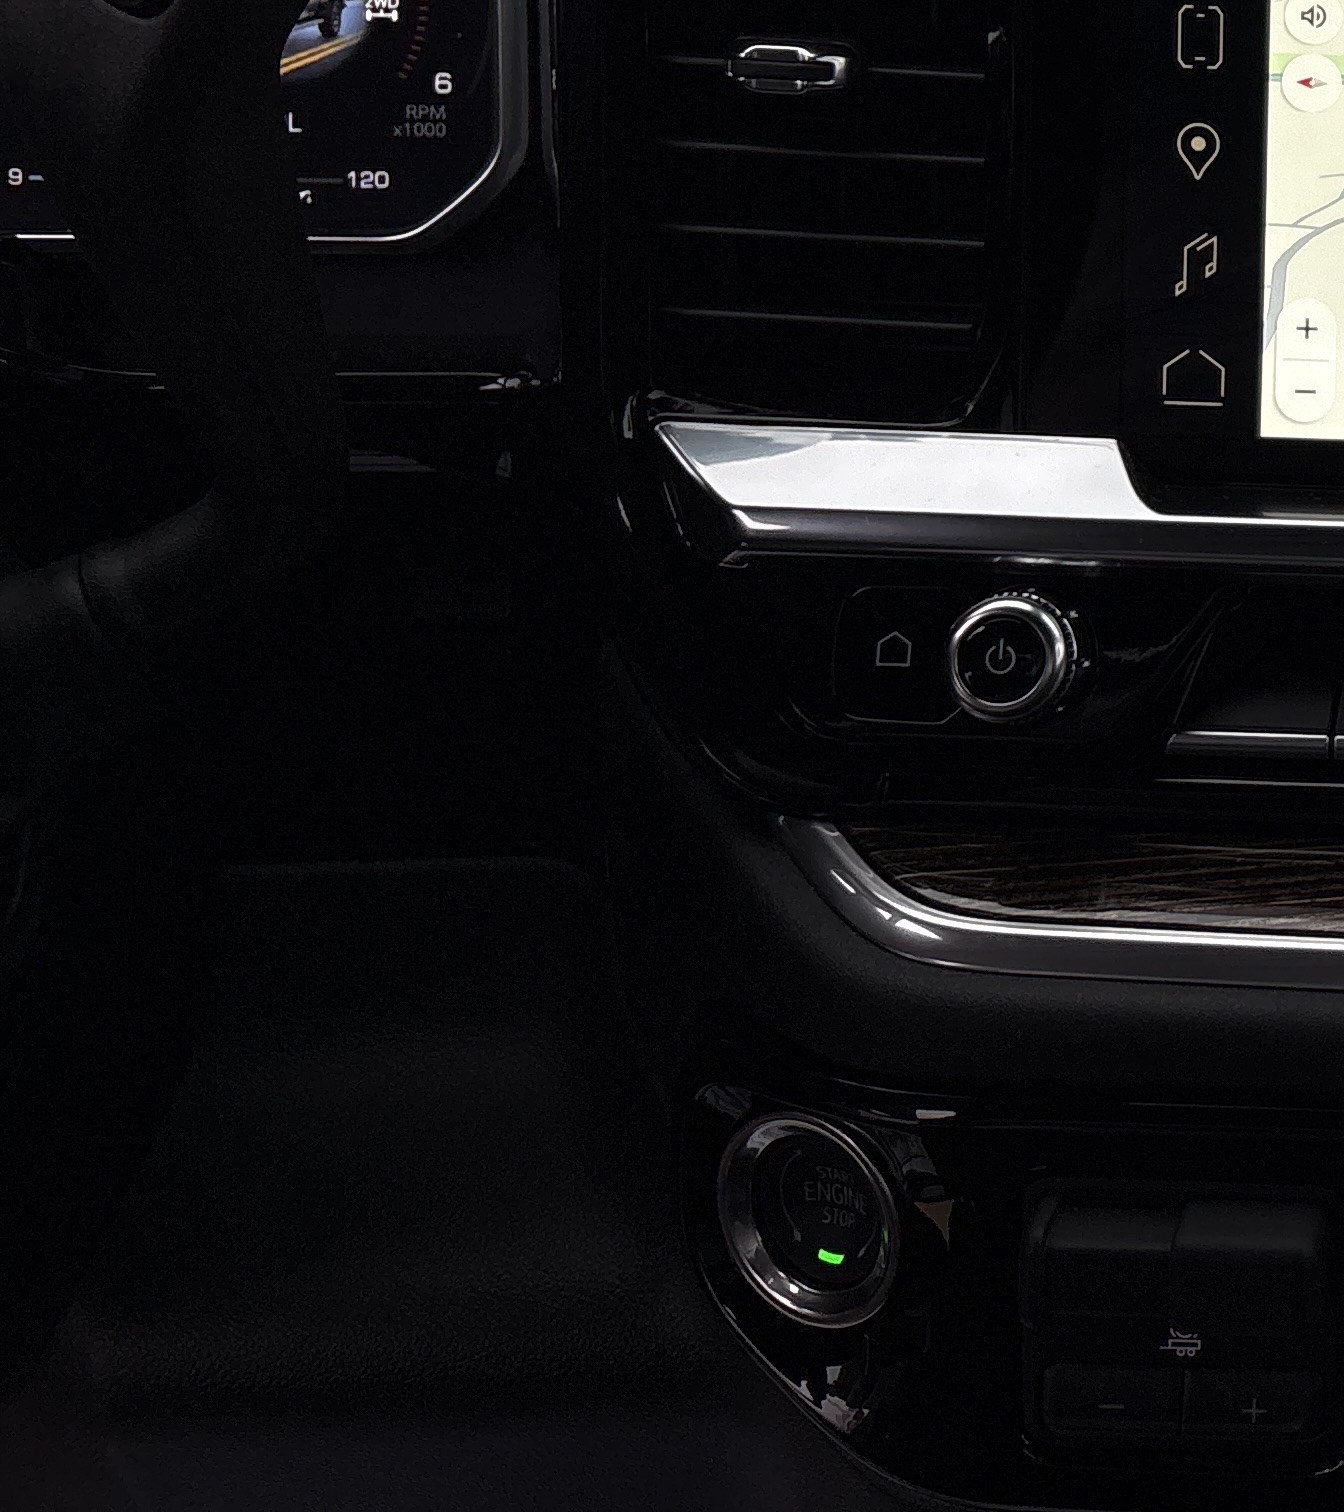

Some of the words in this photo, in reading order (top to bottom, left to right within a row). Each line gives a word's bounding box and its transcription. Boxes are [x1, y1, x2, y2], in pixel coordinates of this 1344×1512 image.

[434, 72, 453, 95] 6
[405, 104, 447, 120] RPM
[288, 112, 303, 133] L
[393, 122, 447, 138] x1000
[8, 168, 23, 185] 9
[347, 170, 390, 189] 120
